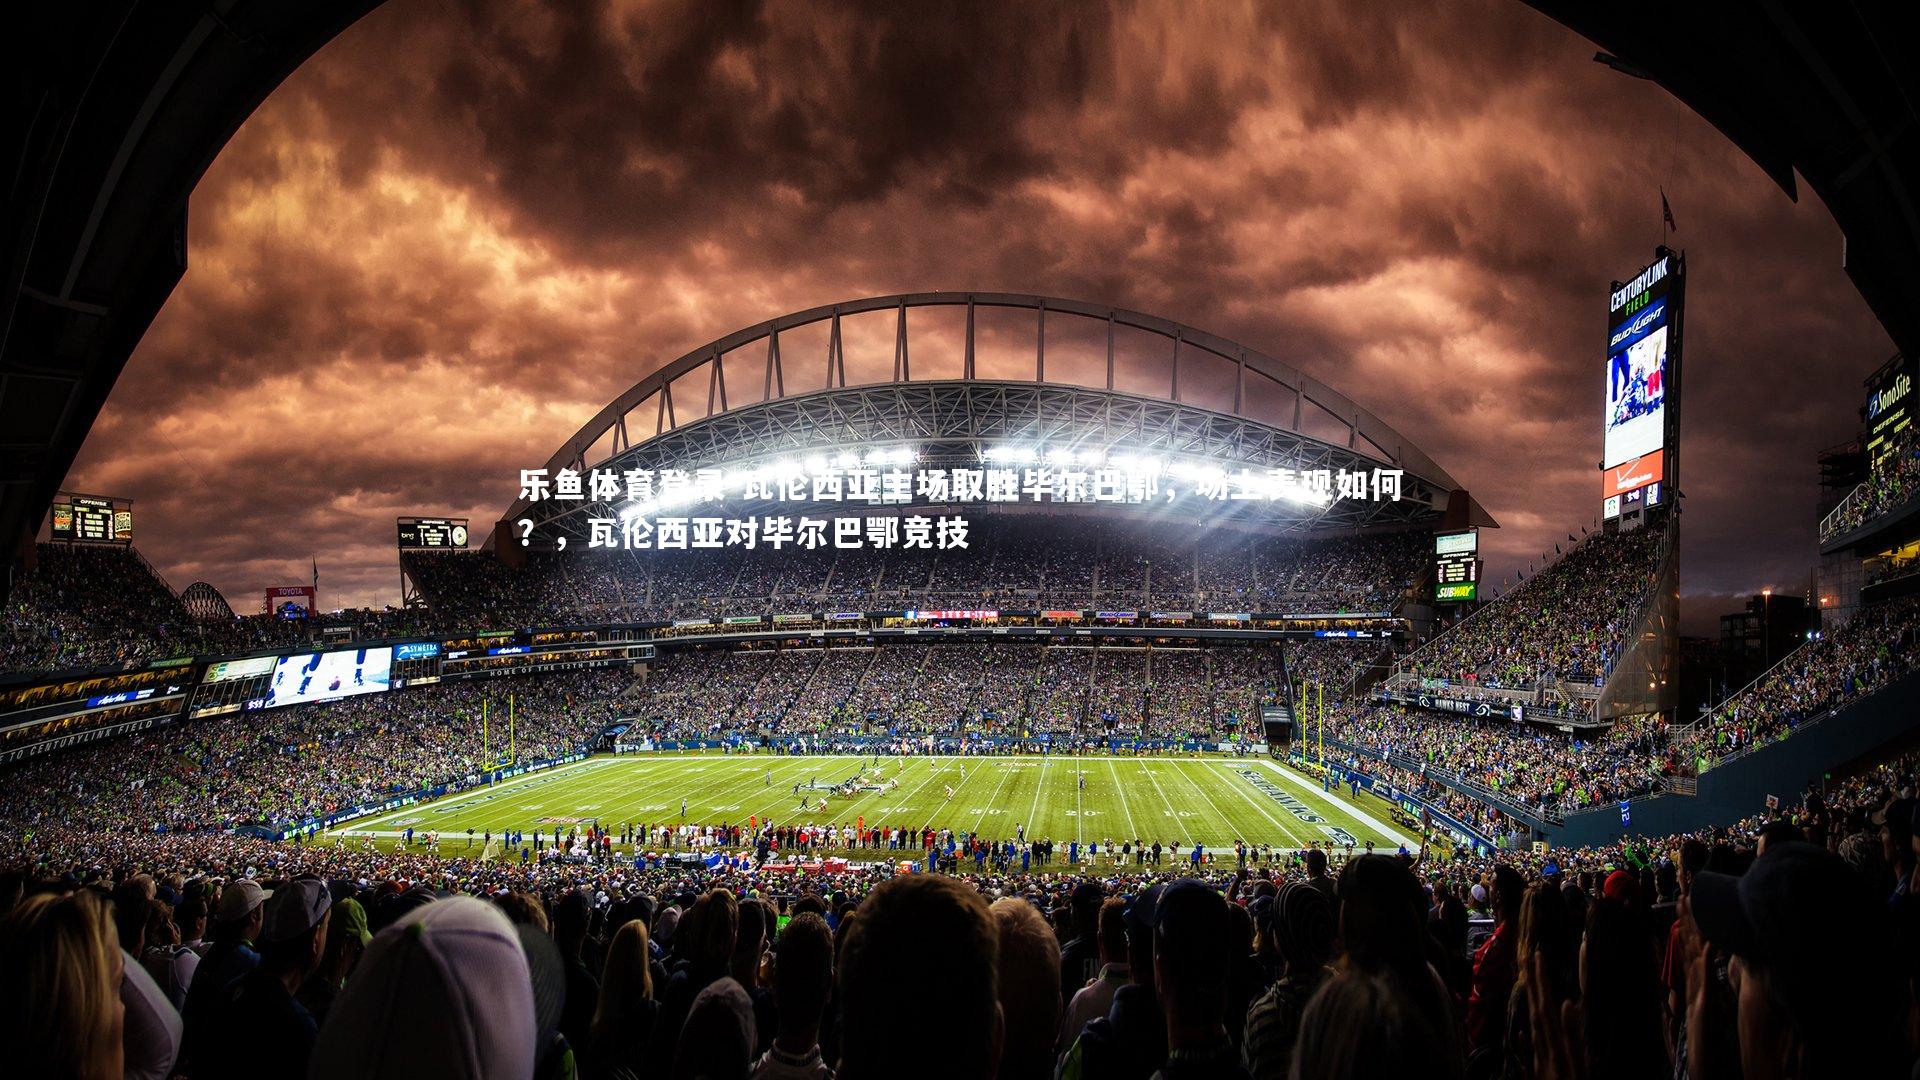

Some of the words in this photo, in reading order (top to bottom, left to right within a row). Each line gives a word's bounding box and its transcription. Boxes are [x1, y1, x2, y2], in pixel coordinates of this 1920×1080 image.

[1611, 256, 1668, 312] CENTURYLINK
[1625, 290, 1650, 316] FIELD
[1611, 326, 1632, 347] BUD
[1633, 305, 1664, 332] LIGHT
[1878, 374, 1911, 413] SonoSite
[1873, 408, 1905, 434] DEFENSE
[80, 499, 107, 507] OFFENSE
[401, 532, 414, 540] bing
[1437, 585, 1474, 599] SUBWAY
[489, 668, 516, 677] HOME
[537, 664, 555, 672] THE
[589, 660, 610, 668] MAN
[1434, 698, 1454, 711] HAWKS
[1455, 702, 1470, 712] NEST
[9, 749, 23, 762] TO
[30, 728, 112, 756] CENTURYLINK
[118, 720, 153, 735] FIELD
[1236, 769, 1329, 823] SEAHAWKS
[1065, 809, 1096, 817] 20
